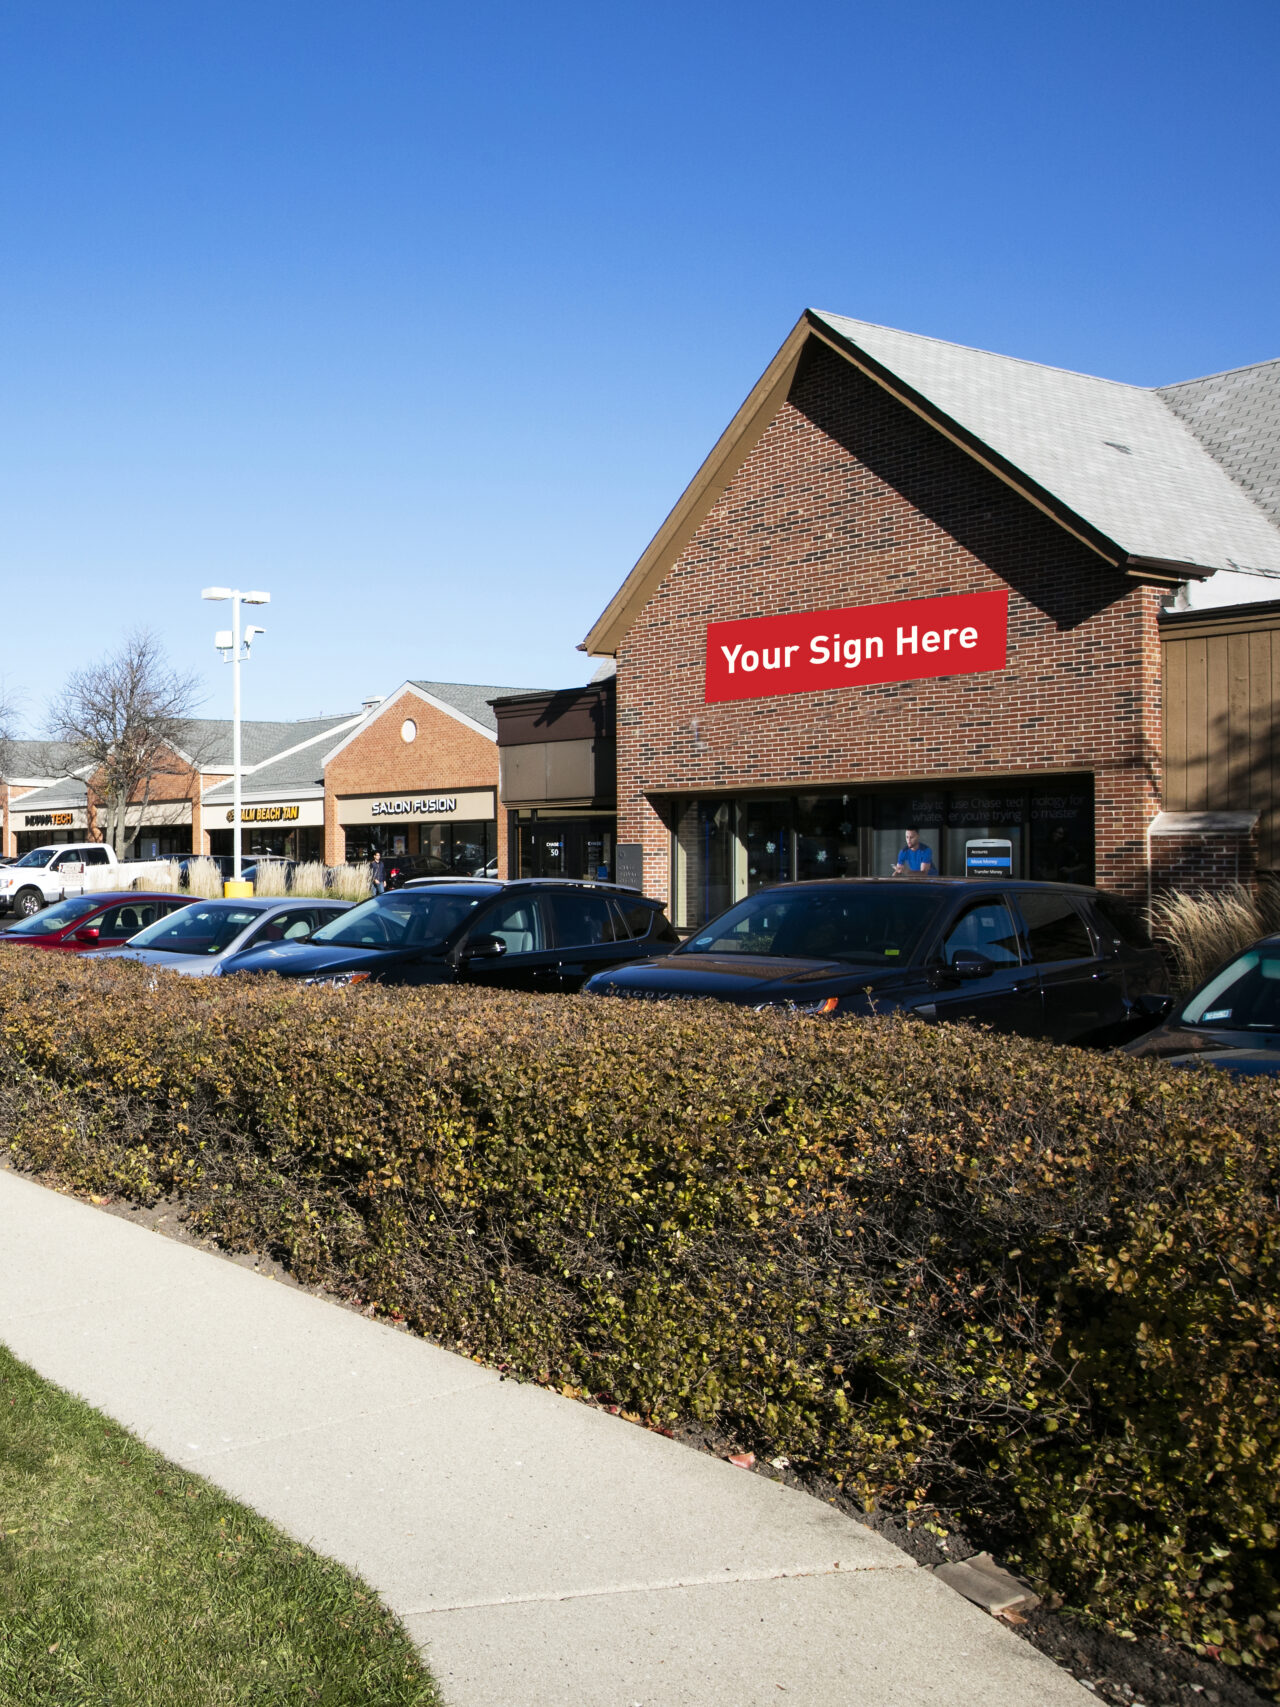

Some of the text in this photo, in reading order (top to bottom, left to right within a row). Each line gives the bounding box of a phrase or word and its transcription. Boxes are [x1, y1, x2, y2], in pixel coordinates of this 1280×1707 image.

[372, 798, 456, 815] SALON FUSION
[912, 799, 932, 812] Easy
[951, 800, 968, 809] use
[971, 797, 1001, 809] Chase
[240, 806, 299, 822] ALM BEACH TAN
[992, 809, 1022, 823] trying
[550, 848, 559, 857] 50
